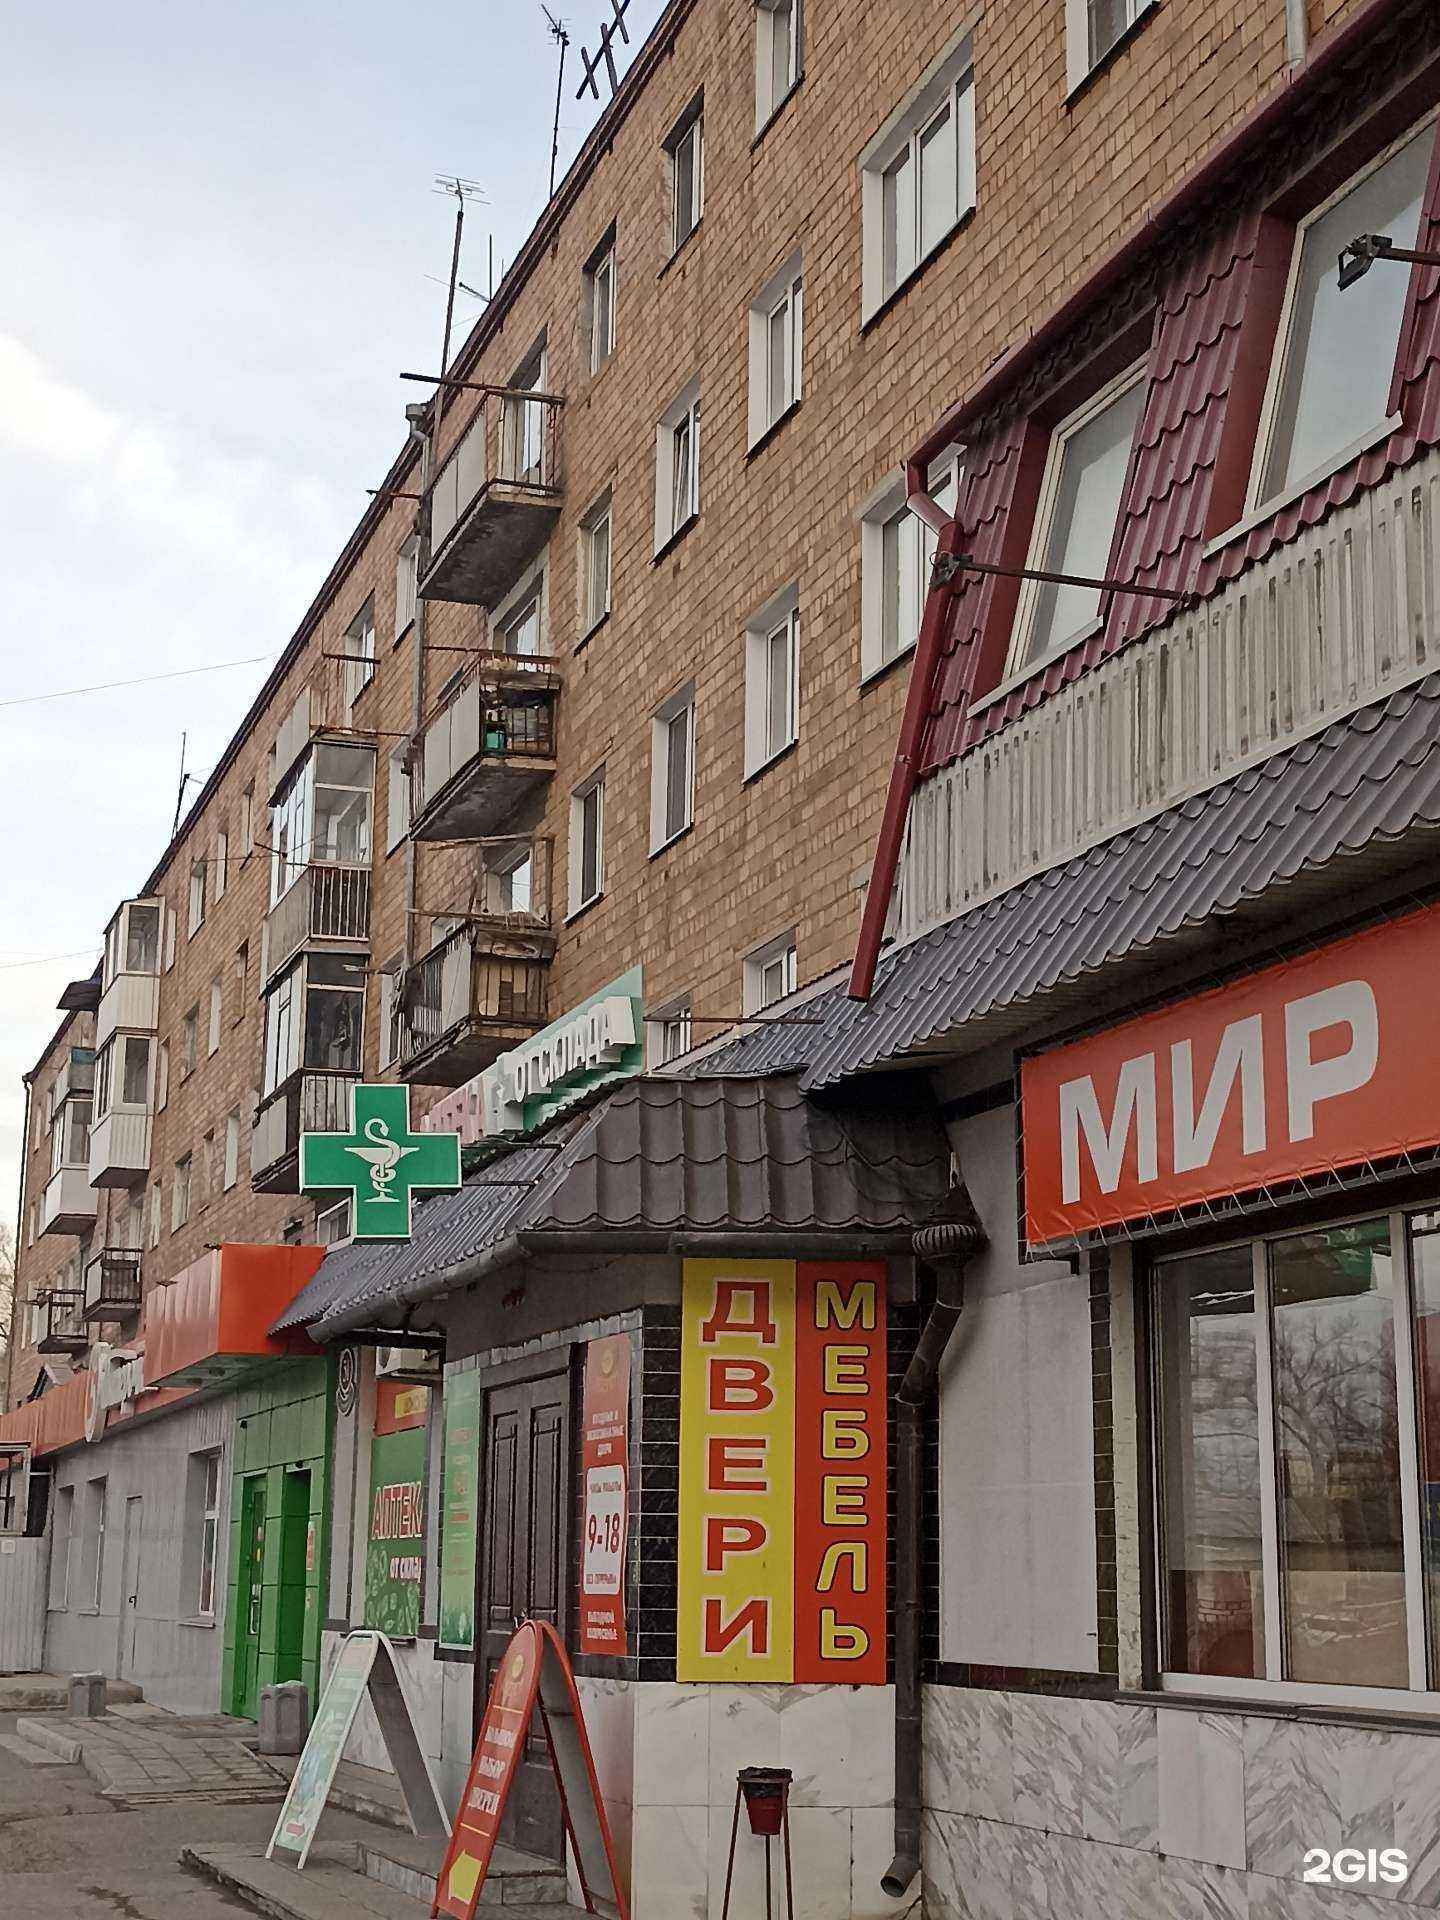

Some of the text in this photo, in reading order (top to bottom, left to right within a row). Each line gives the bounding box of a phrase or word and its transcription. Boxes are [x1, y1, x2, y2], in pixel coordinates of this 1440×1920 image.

[1059, 980, 1379, 1205] МИР
[371, 1481, 423, 1540] АПТЕК
[588, 1512, 620, 1554] 9-18
[699, 1277, 778, 1658] ДВЕРИ
[815, 1280, 877, 1660] МЕБЕЛЬ
